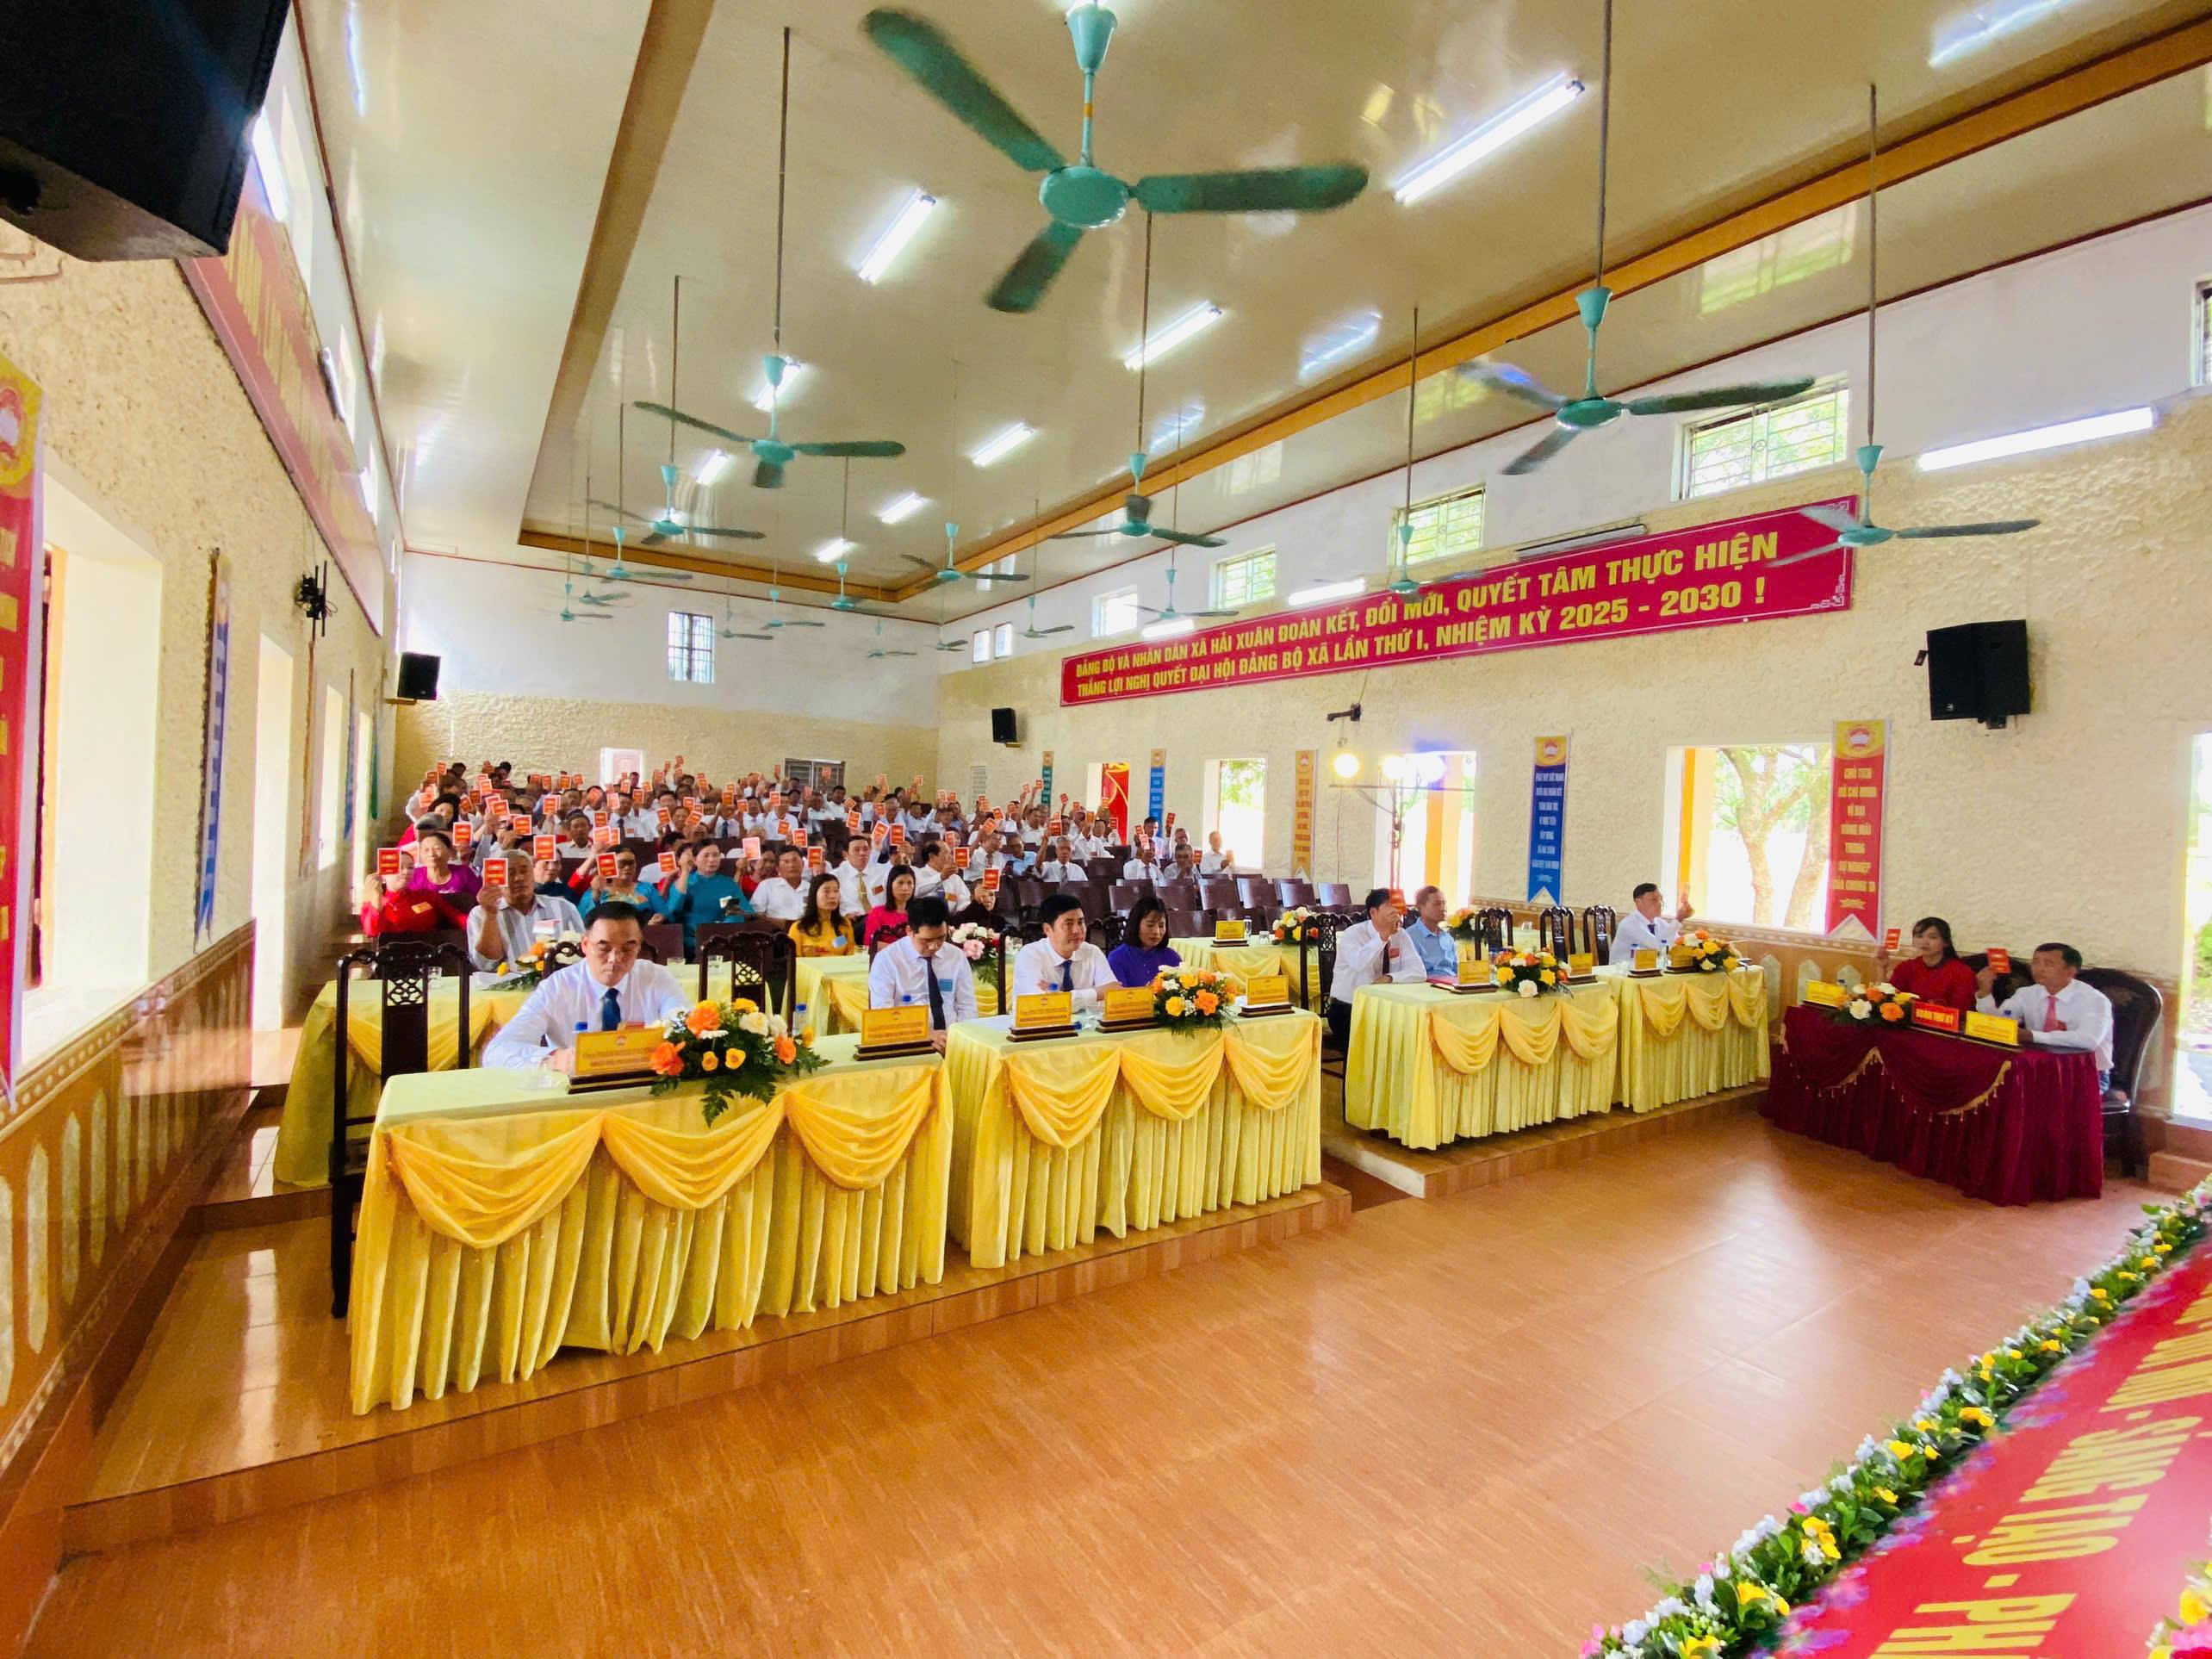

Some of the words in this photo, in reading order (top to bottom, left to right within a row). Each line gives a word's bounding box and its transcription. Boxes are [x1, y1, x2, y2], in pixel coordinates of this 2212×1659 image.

[1076, 658, 1101, 678] ĐẢNG
[1103, 655, 1115, 675] BỘ
[1118, 652, 1130, 670] VÀ
[1132, 648, 1162, 668] NHÂN
[1165, 643, 1189, 662] DÂN
[1190, 637, 1207, 658] XÃ
[1210, 631, 1233, 655] HẢI
[1236, 625, 1275, 650] XUÂN
[1278, 618, 1321, 643] ĐOÀN
[1326, 606, 1360, 634] KẾT,
[1365, 596, 1397, 627] ĐỔI
[1403, 591, 1450, 621] MỚI,
[1457, 572, 1531, 612] QUYẾT
[1538, 565, 1596, 597] TÂM
[1606, 549, 1684, 585] THỰC
[1694, 531, 1778, 571] HIỆN
[1078, 677, 1107, 698] THẮNG
[1108, 678, 1124, 696] LỢI
[1126, 674, 1151, 691] NGHỊ
[1153, 663, 1187, 688] QUYẾT
[1190, 663, 1210, 684] ĐẠI
[1213, 657, 1236, 680] HỘI
[1239, 650, 1278, 675] ĐẢNG
[1282, 646, 1303, 671] BỘ
[1307, 642, 1329, 666] XÃ
[1334, 634, 1369, 662] LẦN
[1374, 628, 1413, 656] THỨ
[1416, 630, 1429, 651] I,
[1436, 614, 1512, 647] NHIỆM
[1519, 605, 1551, 636] KỲ
[1559, 598, 1628, 631] 2025
[1659, 581, 1742, 617] 2030
[1755, 576, 1765, 604] !
[1951, 1494, 2149, 1565] TẠO
[1867, 1594, 2078, 1659] PH
